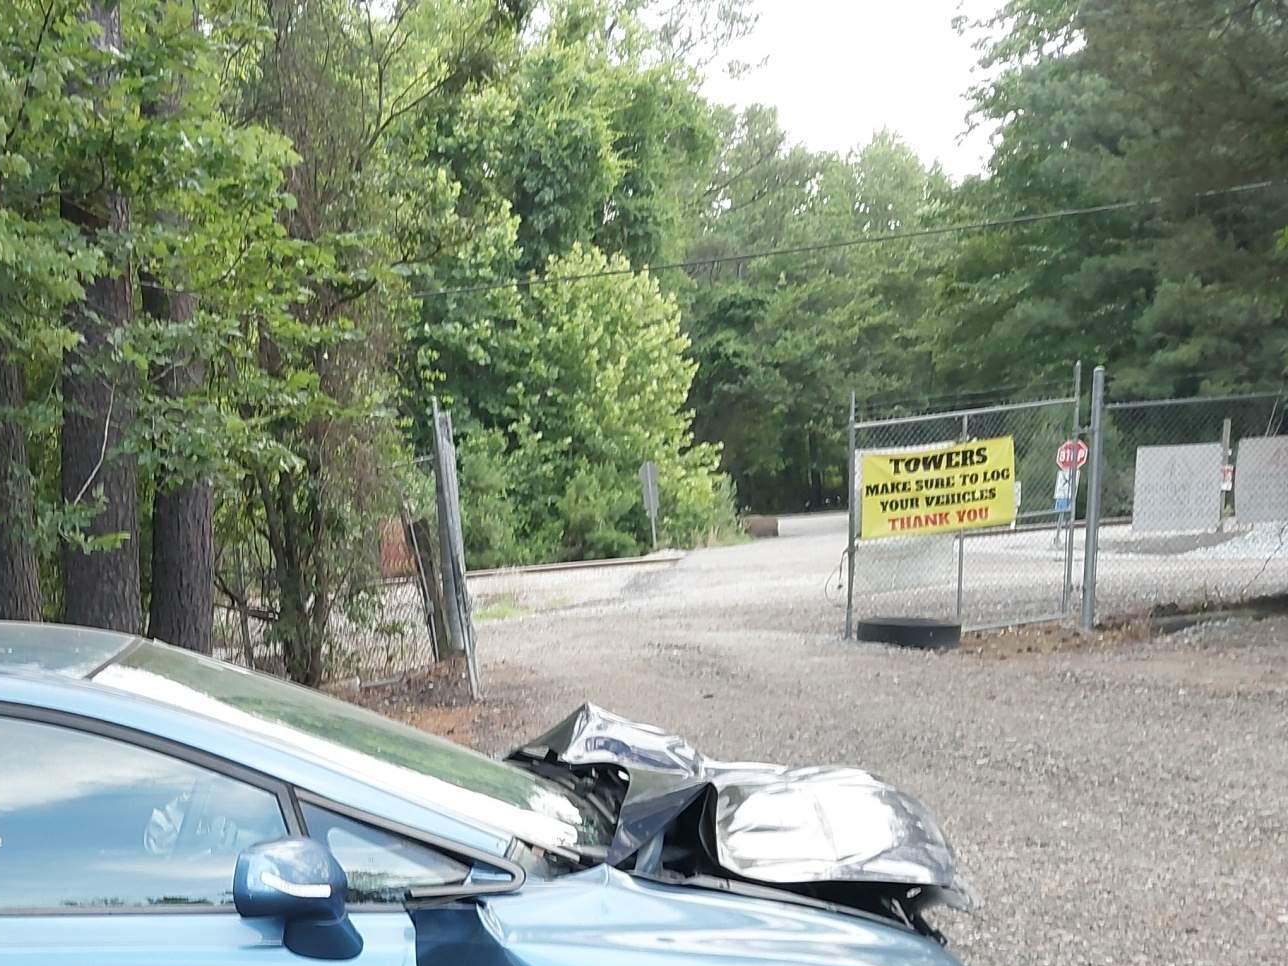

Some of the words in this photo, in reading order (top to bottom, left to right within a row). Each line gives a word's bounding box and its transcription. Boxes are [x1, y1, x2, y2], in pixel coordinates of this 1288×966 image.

[889, 447, 988, 475] TOWERS
[865, 481, 912, 497] MAKE
[915, 477, 955, 491] SURE
[959, 473, 979, 486] TO
[982, 468, 1010, 483] LOG
[880, 497, 919, 513] YOUR
[925, 488, 996, 508] VEHICLES
[888, 512, 950, 531] THANK
[956, 507, 990, 524] YOU
